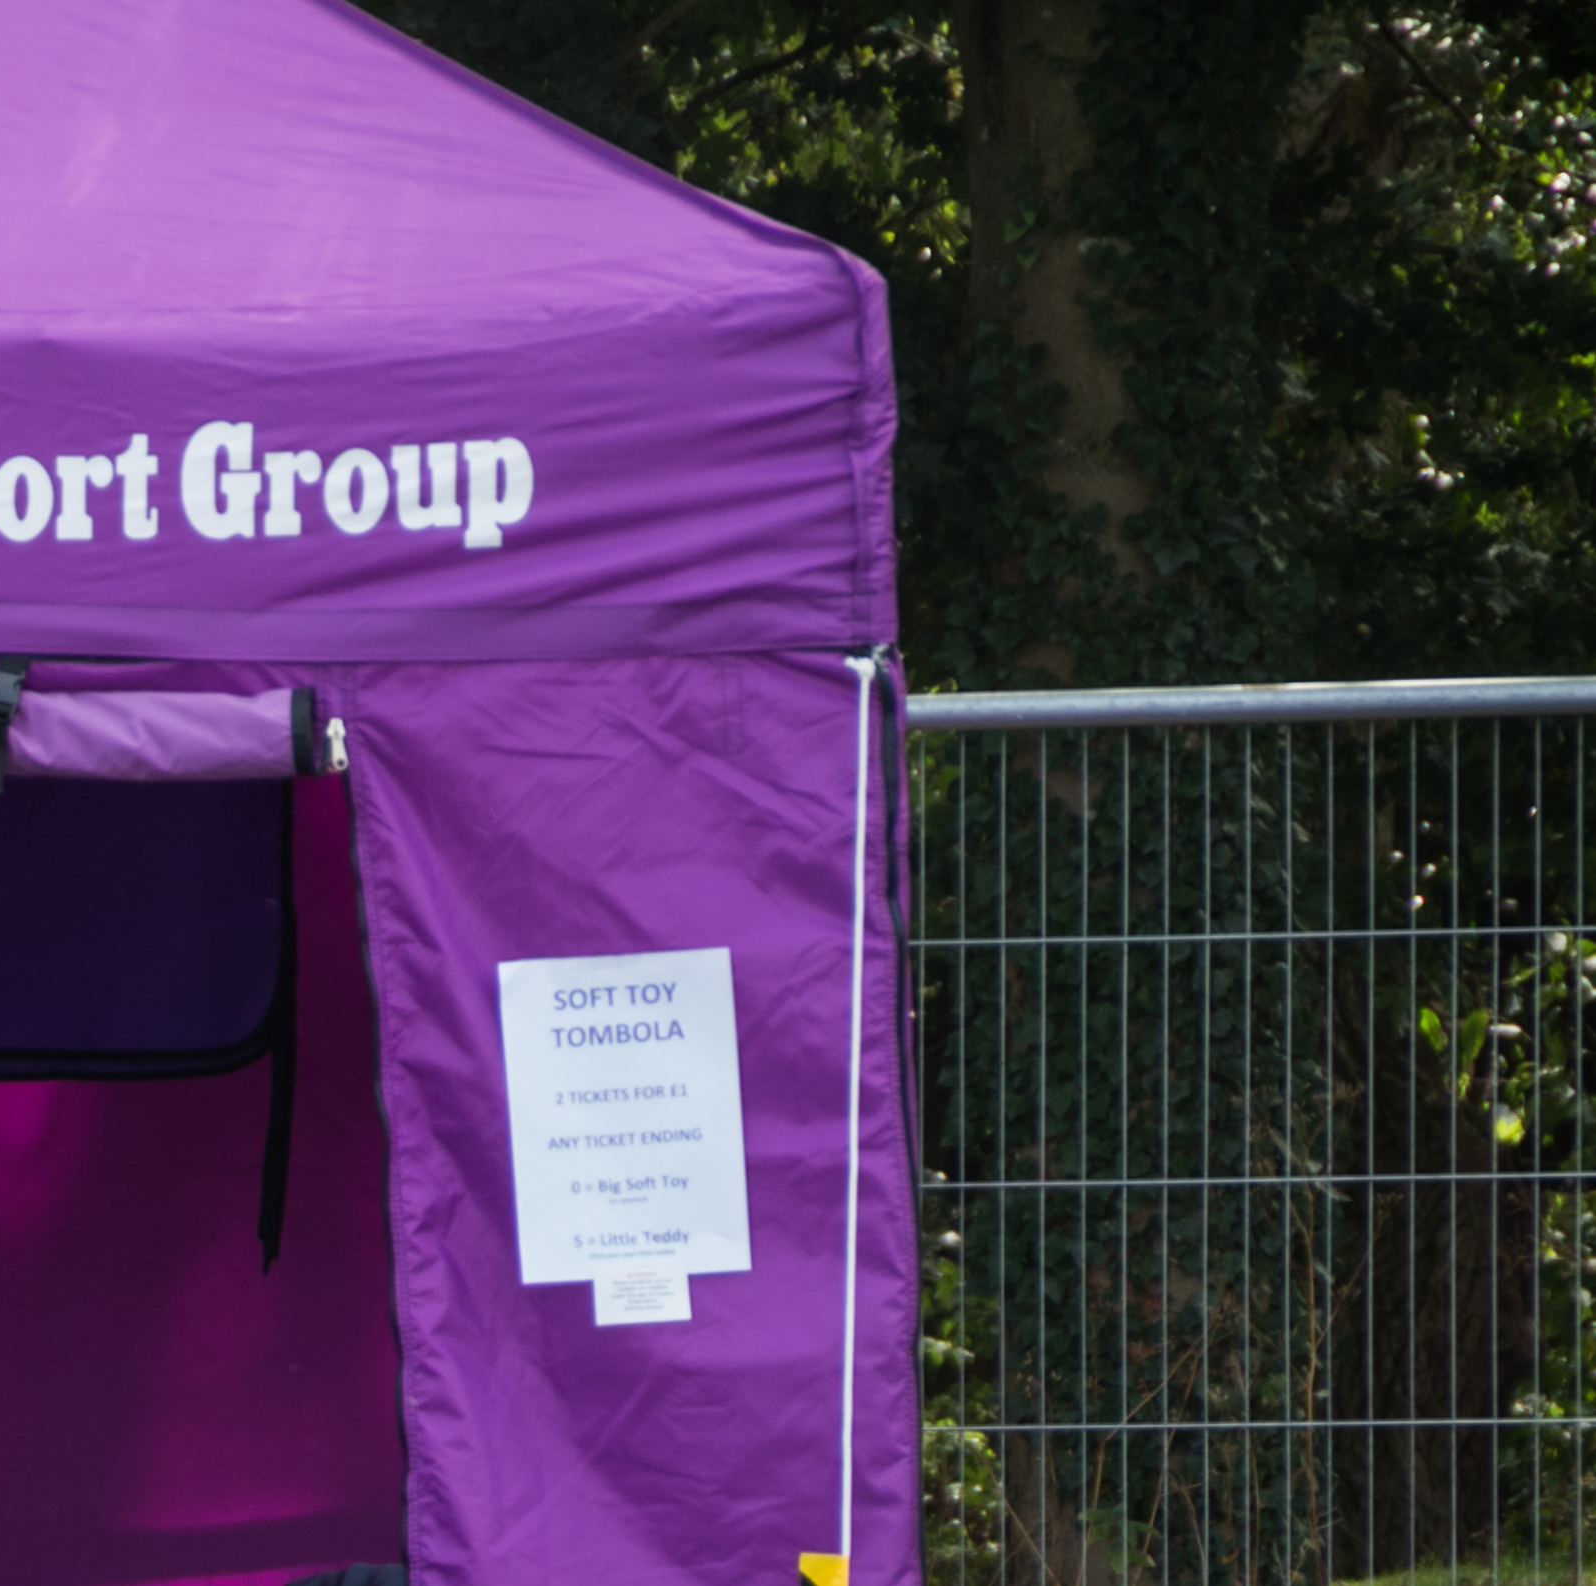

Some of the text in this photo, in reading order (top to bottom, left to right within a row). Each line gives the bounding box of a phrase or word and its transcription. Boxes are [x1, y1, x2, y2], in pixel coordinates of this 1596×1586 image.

[180, 422, 535, 549] Group
[553, 982, 677, 1011] SOFT TOY
[551, 1019, 685, 1048] TOMBOLA
[556, 1083, 688, 1105] 2 TICKETS FOR £1
[548, 1127, 703, 1150] ANY TICKET ENDING
[598, 1179, 621, 1195] Big
[626, 1176, 656, 1191] Soft
[661, 1175, 689, 1189] Toy
[600, 1233, 638, 1247] Little
[643, 1229, 690, 1245] Teddy
